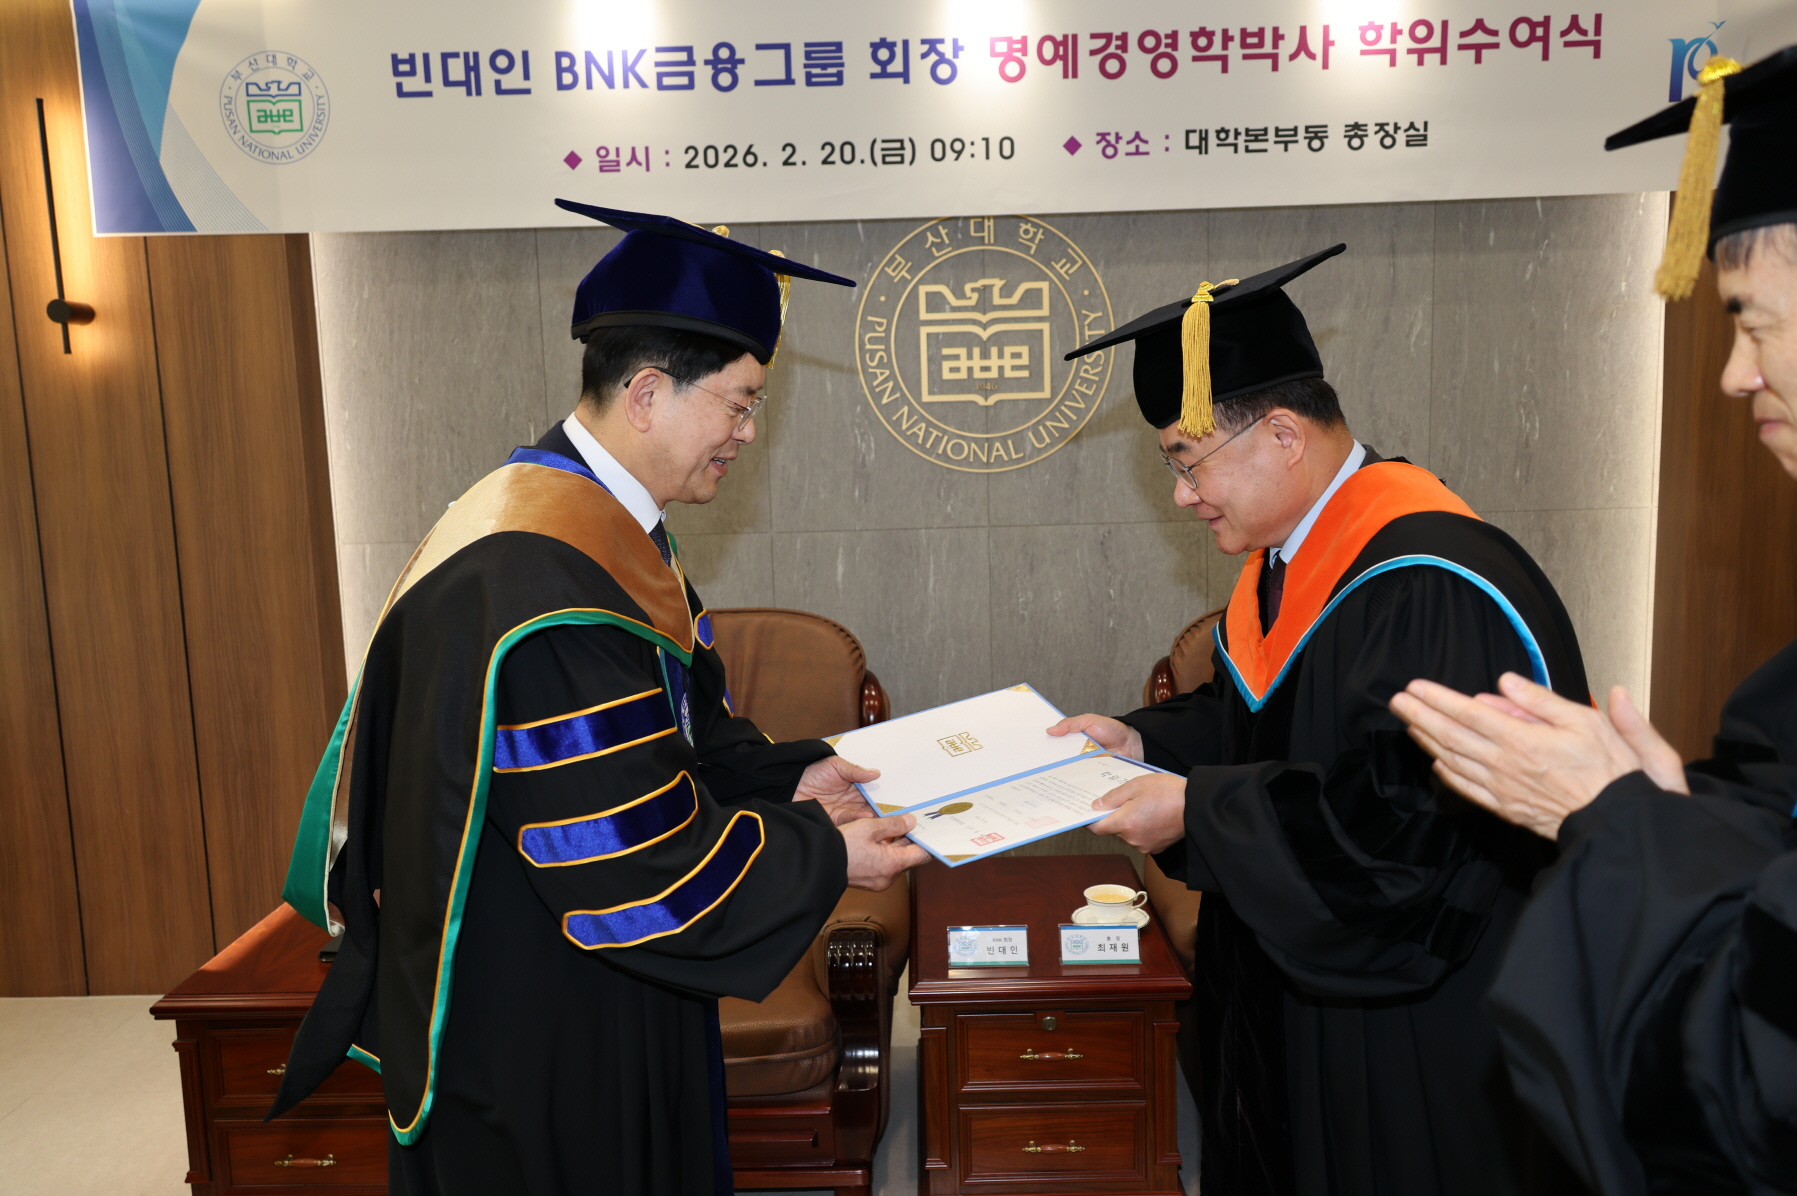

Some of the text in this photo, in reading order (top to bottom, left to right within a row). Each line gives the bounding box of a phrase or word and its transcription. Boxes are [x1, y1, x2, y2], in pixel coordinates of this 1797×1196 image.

[231, 53, 315, 82] 부산대학교
[390, 12, 1603, 99] 빈대인 BNK금융그룹 회장 명예경영학박사 학위수여식
[223, 94, 326, 161] PUSAN NATIONAL UNIVERSITY
[595, 145, 651, 173] 일시
[683, 143, 768, 170] 2026.
[781, 142, 807, 167] 2.
[820, 136, 917, 168] 20.(금)
[929, 135, 1016, 163] 09:10
[1095, 130, 1151, 160] 장소
[1184, 124, 1330, 156] 대학본부동
[1342, 120, 1430, 152] 총장실
[884, 215, 1084, 284] 부산대학교
[864, 309, 1106, 463] PUSAN NATIONAL UNIVERSTY
